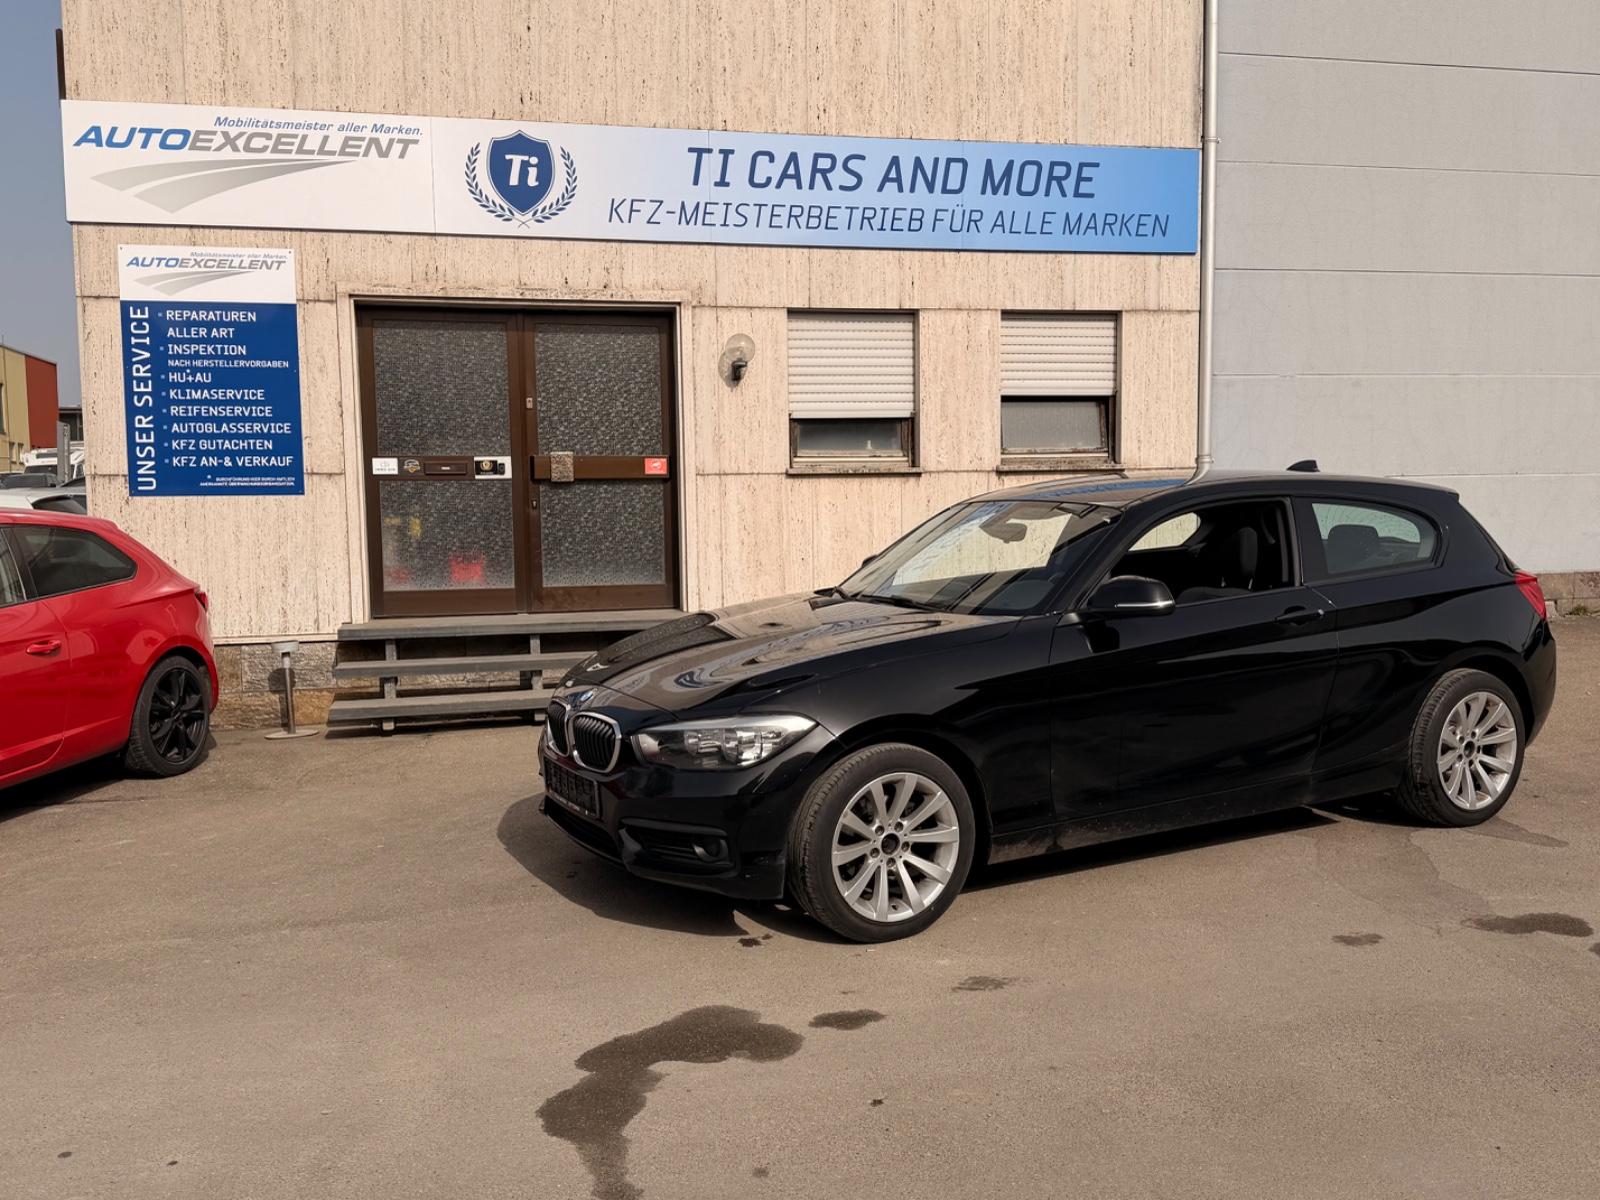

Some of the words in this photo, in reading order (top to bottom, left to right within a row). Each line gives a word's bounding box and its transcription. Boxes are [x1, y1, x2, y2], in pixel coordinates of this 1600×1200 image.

[214, 116, 334, 132] Mobilitätsmeister
[337, 121, 368, 133] aller
[371, 123, 424, 137] Marken.
[73, 126, 420, 159] AUTOEXCELLENT
[505, 154, 539, 187] Ti
[688, 147, 735, 187] TI
[748, 150, 867, 192] CARS
[877, 156, 968, 194] AND
[980, 158, 1100, 199] MORE
[608, 198, 926, 233] KFZ-MEISTERBETRIEB
[932, 204, 984, 234] FÜR
[990, 210, 1056, 236] ALLE
[1062, 212, 1170, 238] MARKEN
[126, 256, 286, 271] AUTOEXCELLENT
[166, 310, 257, 322] REPARATUREN
[167, 327, 208, 339] ALLER
[211, 328, 235, 339] ART
[168, 344, 247, 356] INSPEKTION
[129, 306, 153, 408] SERVICE
[168, 359, 191, 368] NACH
[192, 360, 289, 369] HERSTELLERVORGABEN
[169, 389, 265, 401] KLIMASERVICE
[170, 406, 273, 418] REIFENSERVICE
[171, 422, 292, 435] AUTOGLASSERVICE
[172, 440, 196, 451] KFZ
[199, 440, 273, 452] GUTACHTEN
[135, 415, 156, 491] UNSER
[173, 456, 197, 468] KFZ
[236, 456, 293, 468] VERKAUF
